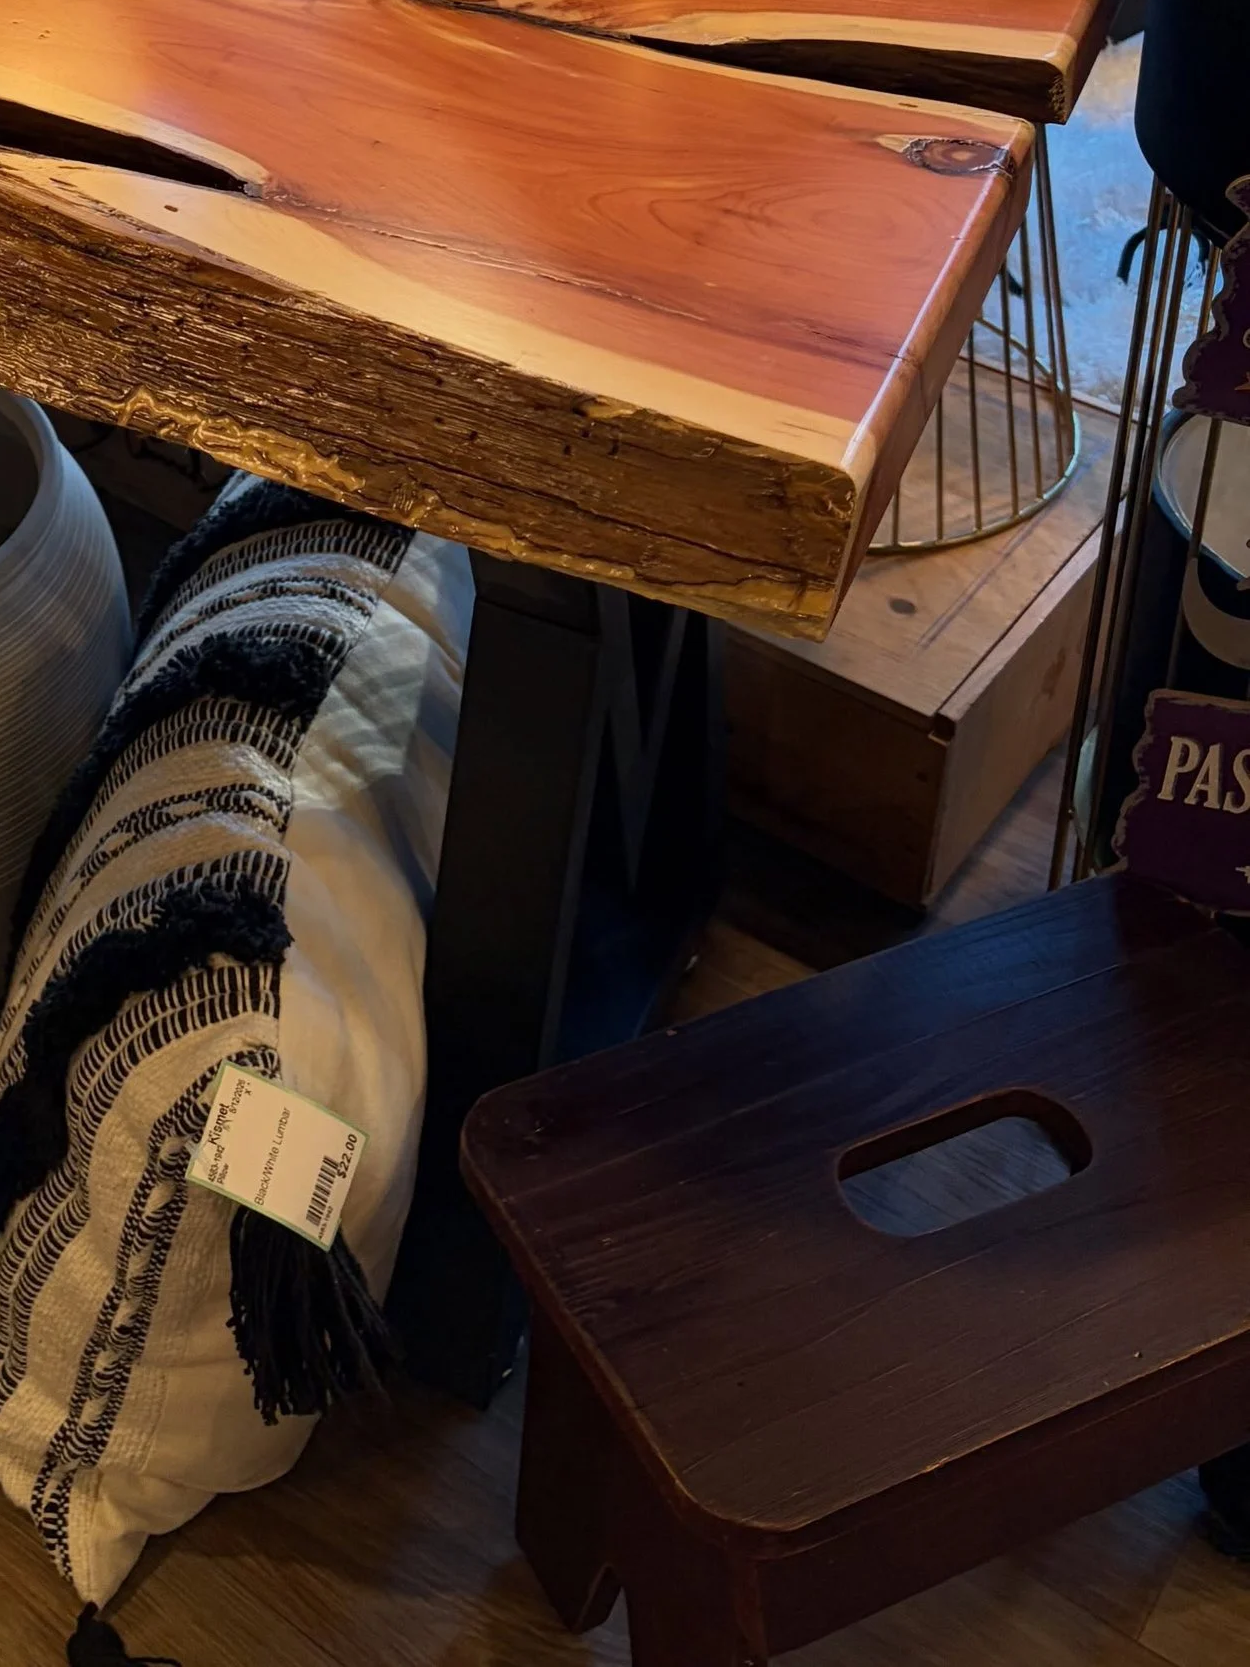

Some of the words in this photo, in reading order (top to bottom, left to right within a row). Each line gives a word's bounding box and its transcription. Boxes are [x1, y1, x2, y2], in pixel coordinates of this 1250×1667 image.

[208, 1103, 230, 1146] Kismet
[254, 1148, 279, 1206] Black/White
[277, 1107, 292, 1147] Lumbar
[336, 1133, 358, 1180] $22.00
